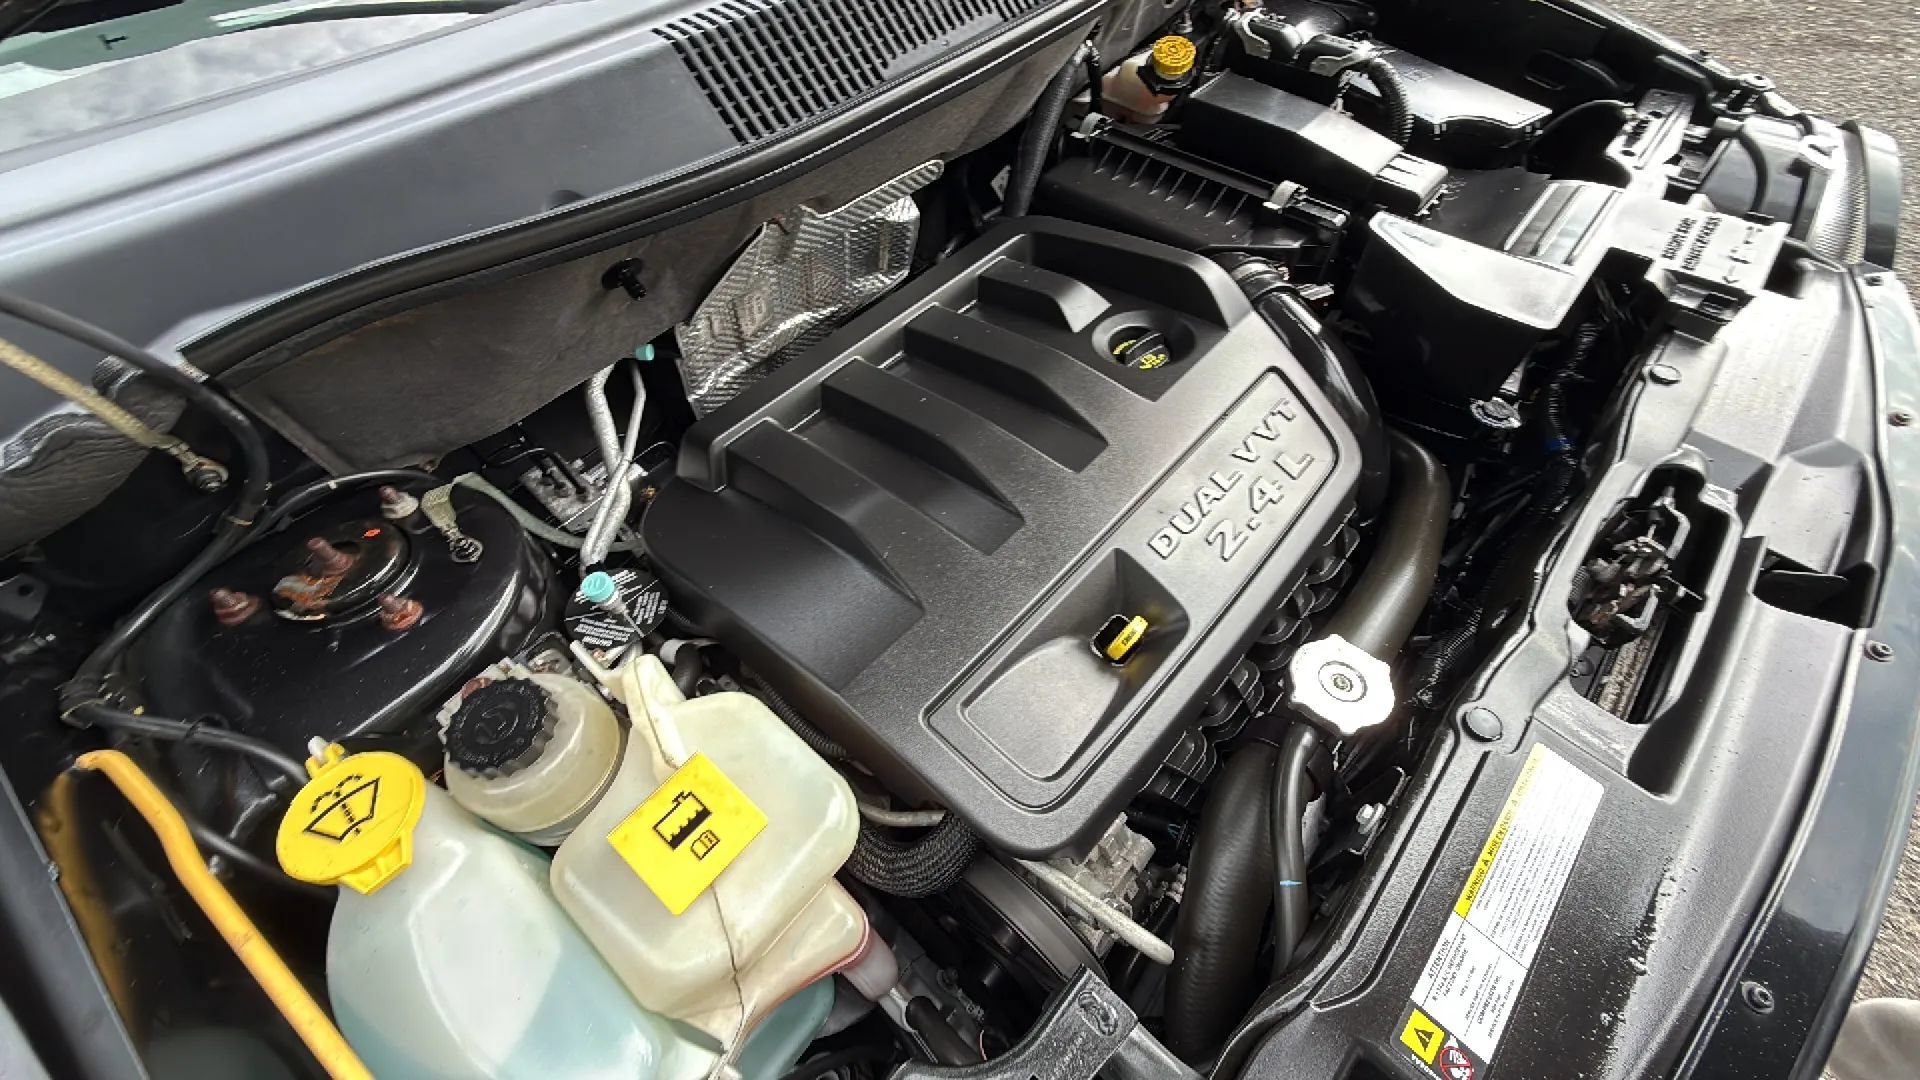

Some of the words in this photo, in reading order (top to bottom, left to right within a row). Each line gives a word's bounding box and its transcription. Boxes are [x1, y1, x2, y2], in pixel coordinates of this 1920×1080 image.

[1147, 471, 1244, 560] DUAL
[1230, 398, 1296, 463] VVT
[1205, 476, 1284, 562] 2.4
[1272, 451, 1315, 480] L
[1428, 938, 1450, 978] ATTENTION
